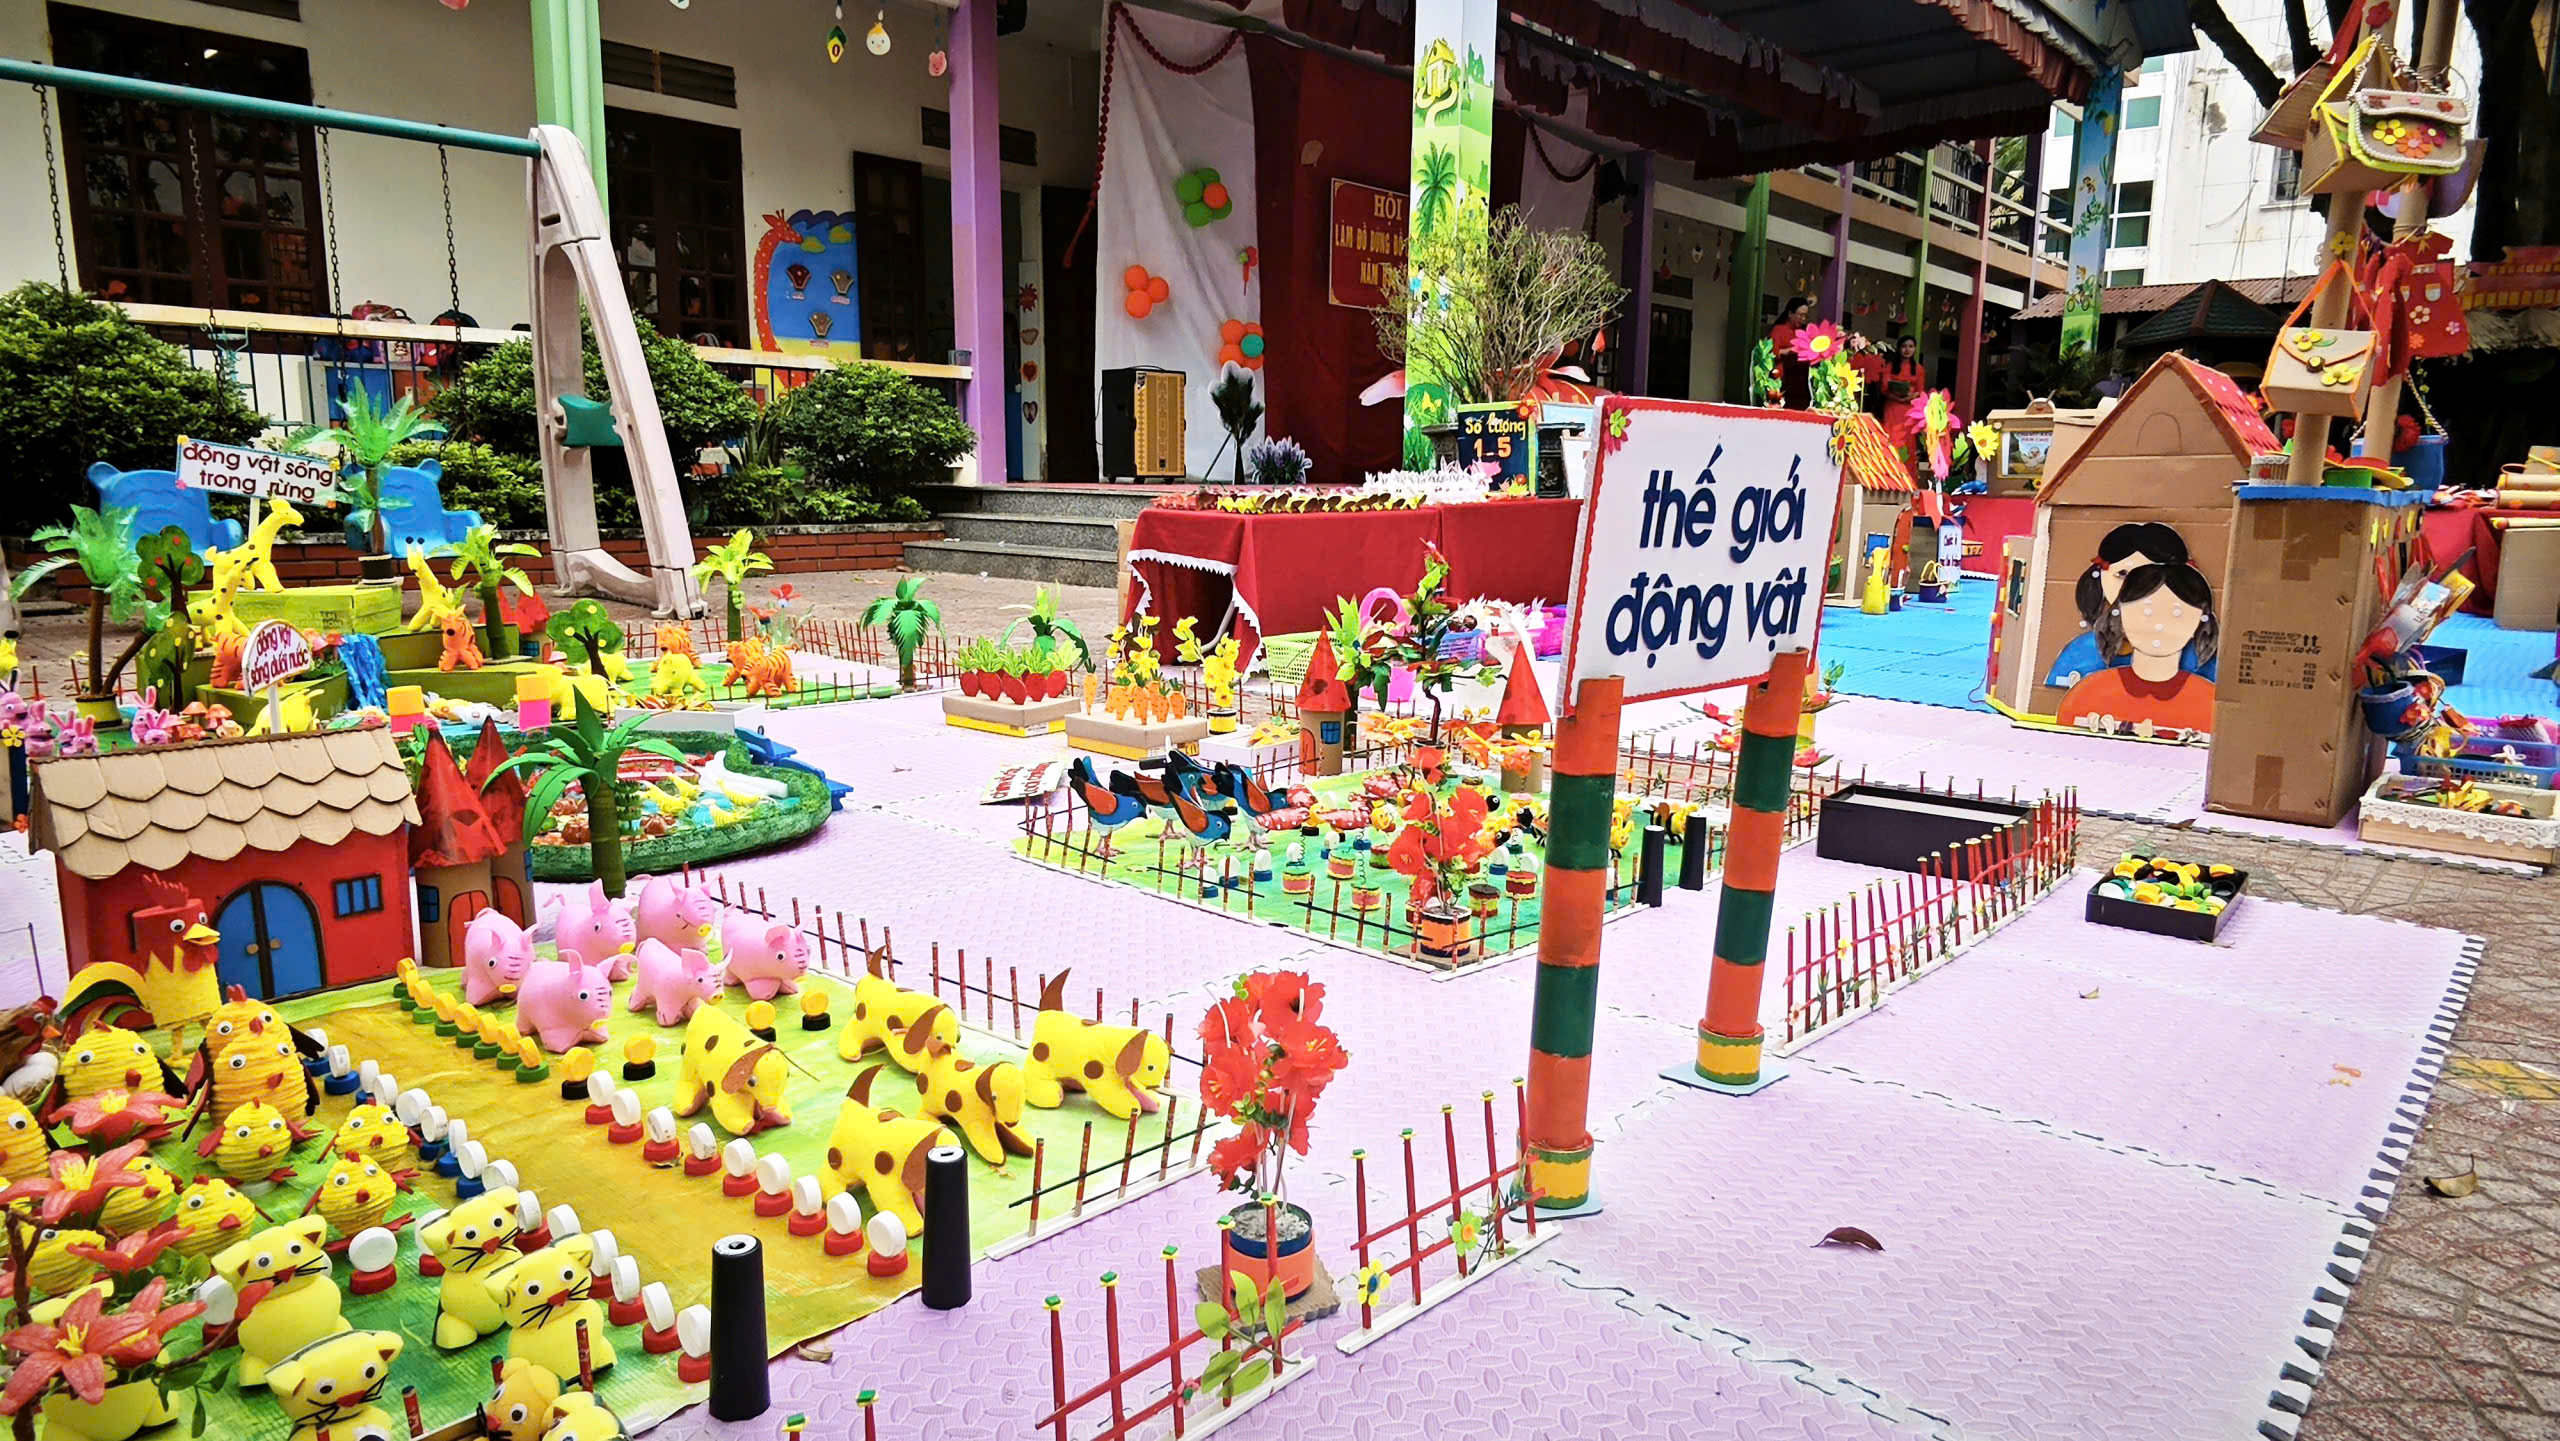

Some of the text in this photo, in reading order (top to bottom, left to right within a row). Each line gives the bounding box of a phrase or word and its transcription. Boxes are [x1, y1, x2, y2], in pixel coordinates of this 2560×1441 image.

[1374, 191, 1403, 226] HỘI
[183, 442, 334, 487] động vật sống
[199, 469, 315, 503] trong rừng
[1639, 442, 1807, 564] thế giới
[1605, 566, 1808, 669] động vật
[256, 627, 279, 657] động
